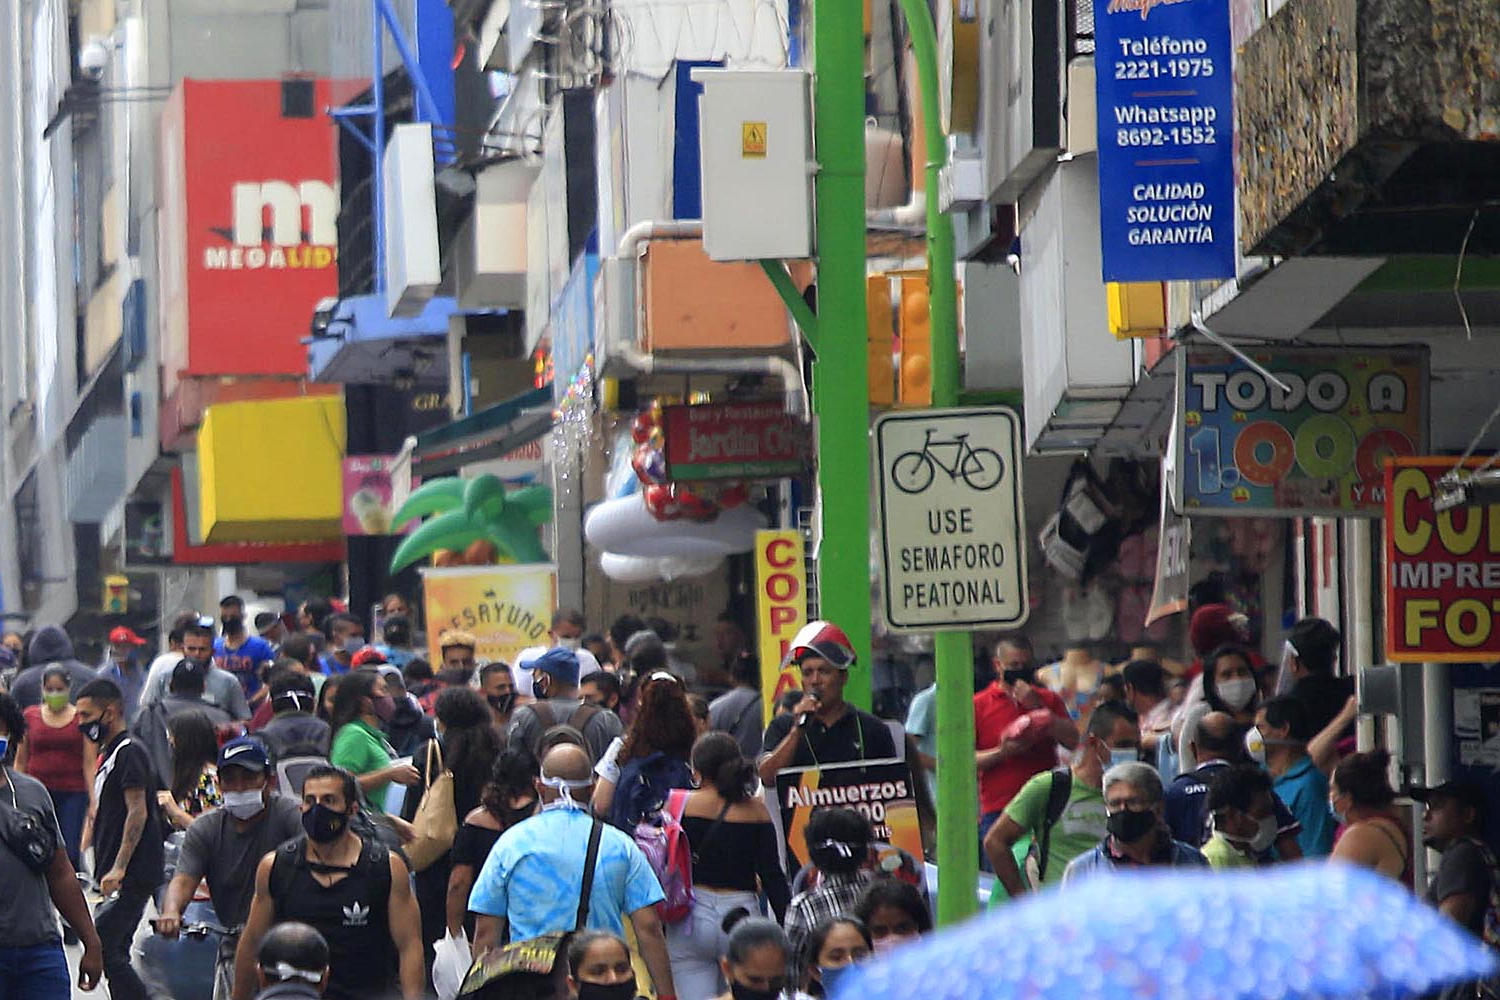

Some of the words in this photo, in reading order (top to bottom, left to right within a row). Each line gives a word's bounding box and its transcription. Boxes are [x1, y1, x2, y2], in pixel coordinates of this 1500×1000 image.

[1119, 37, 1207, 56] Teléfono
[1115, 60, 1214, 79] 2221-1975
[1114, 105, 1216, 128] Whatsapp
[1117, 127, 1216, 146] 8692-1552
[1133, 183, 1204, 201] CALIDAD
[1127, 201, 1212, 223] SOLUCIÓN
[1129, 223, 1213, 245] GARANTÍA
[1192, 371, 1349, 412] TODO
[1367, 372, 1406, 413] A
[929, 508, 973, 535] USE
[902, 543, 1004, 572] SEMAFORO
[904, 579, 1005, 609] PEATONAL
[787, 781, 908, 808] Almuerzos
